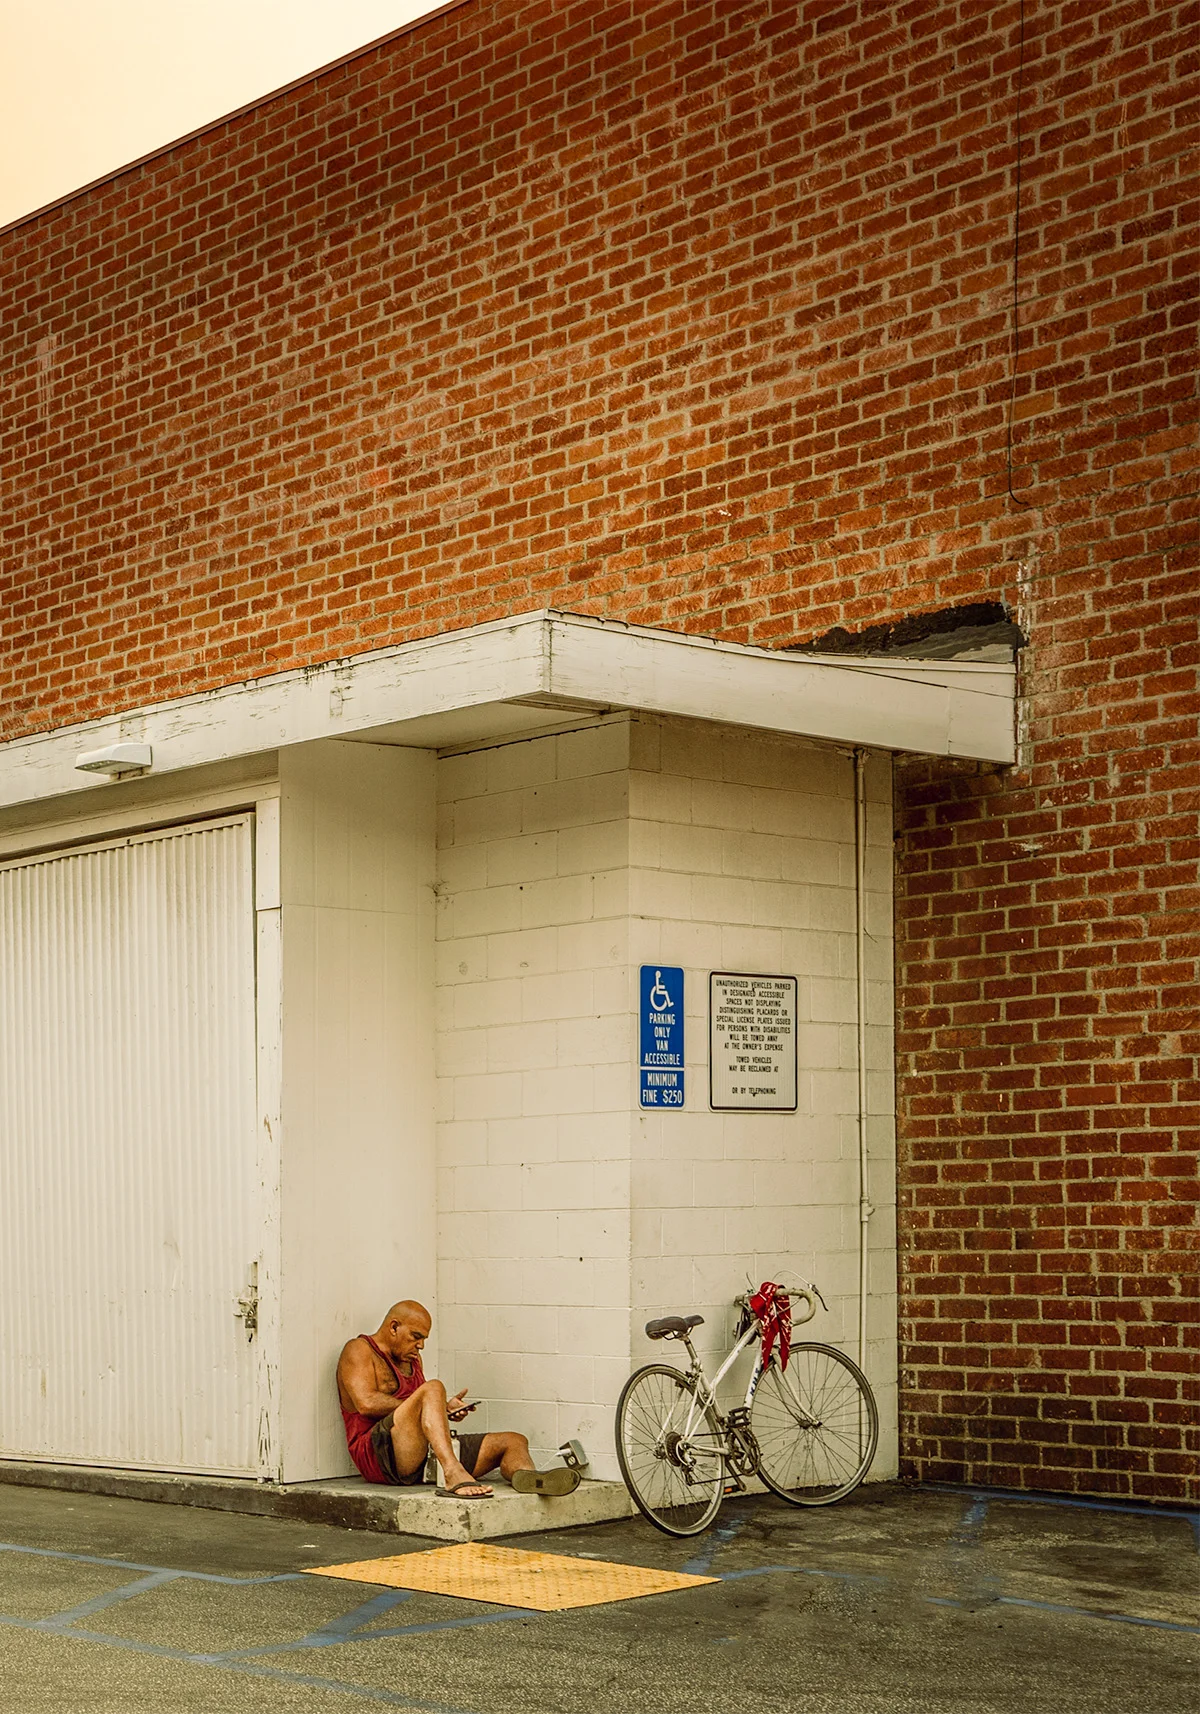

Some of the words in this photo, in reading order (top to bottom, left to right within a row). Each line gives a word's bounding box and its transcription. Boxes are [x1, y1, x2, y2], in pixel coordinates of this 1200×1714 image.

[716, 980, 748, 988] UNAUTHORIZED
[730, 989, 755, 997] DESIGNATED
[759, 991, 784, 999] ACCESSIBLE
[649, 1013, 675, 1025] PARKING
[654, 1027, 670, 1038] ONLY
[763, 1026, 790, 1034] DISABILITIES
[656, 1040, 668, 1051] VAN
[644, 1053, 680, 1065] ACCESSIBLE
[647, 1073, 677, 1086] MINIMUM
[643, 1089, 657, 1103] FINE
[662, 1089, 682, 1104] $250
